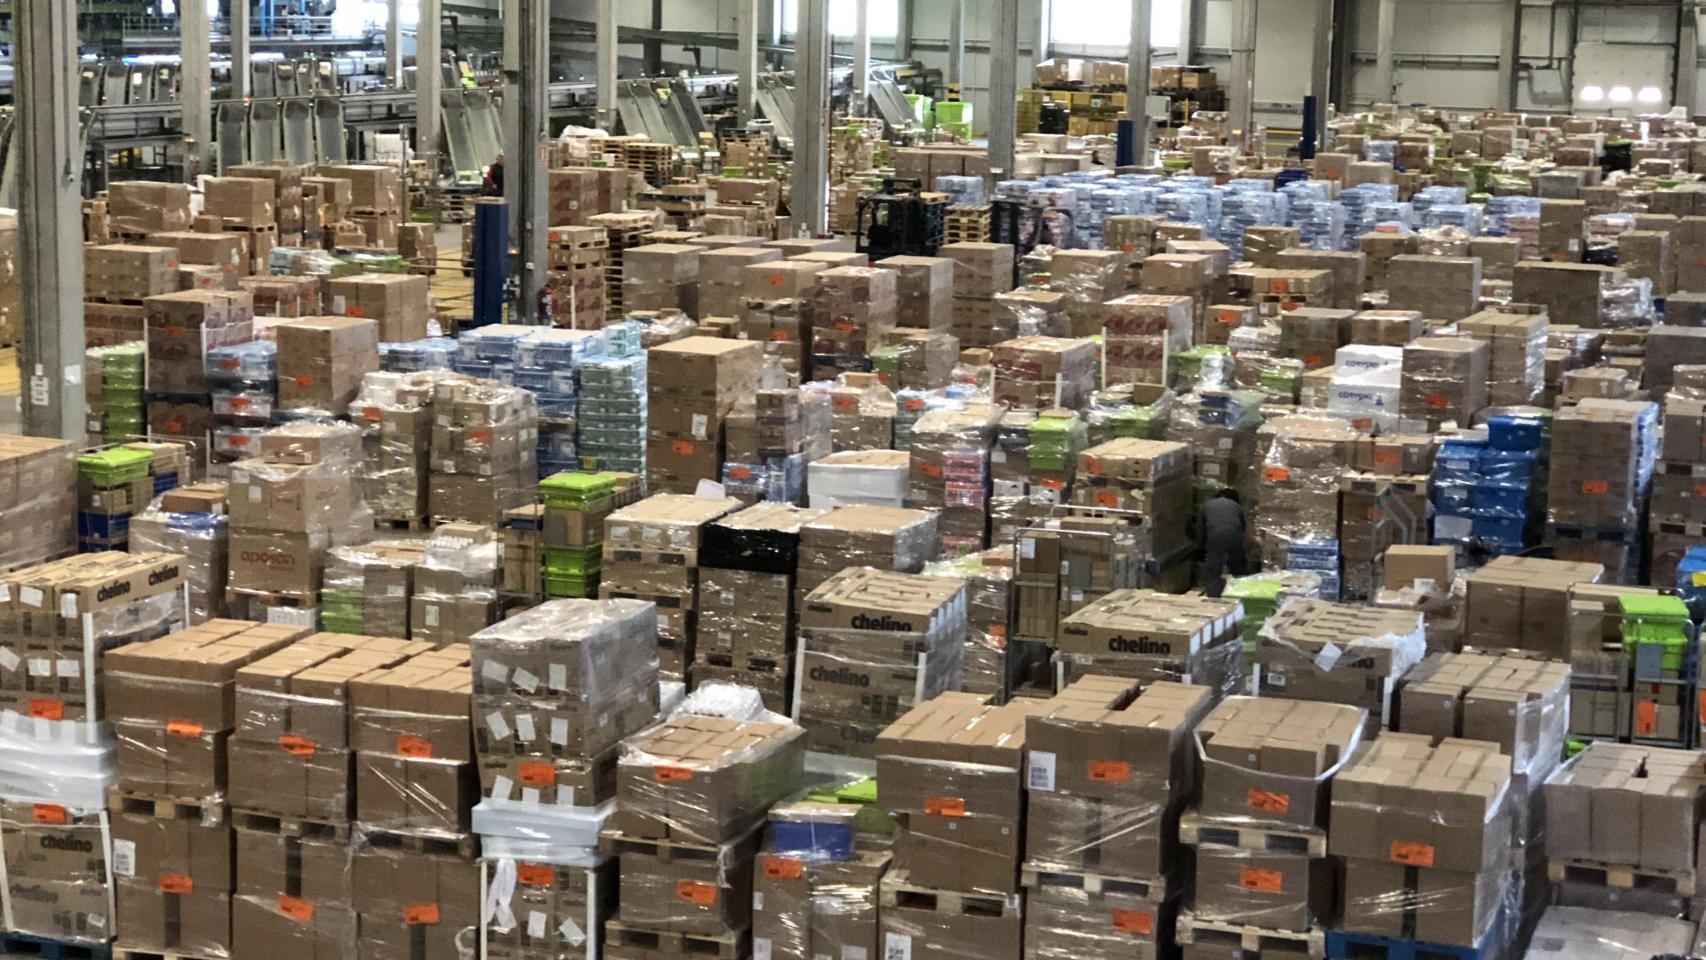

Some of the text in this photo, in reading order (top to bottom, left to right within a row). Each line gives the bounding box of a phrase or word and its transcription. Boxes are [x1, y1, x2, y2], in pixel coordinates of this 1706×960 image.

[148, 564, 179, 587] chelino
[97, 580, 131, 602] chelino
[851, 613, 912, 632] chelino
[1108, 635, 1171, 655] chelino
[810, 665, 870, 688] chelino
[41, 834, 93, 853] chelino
